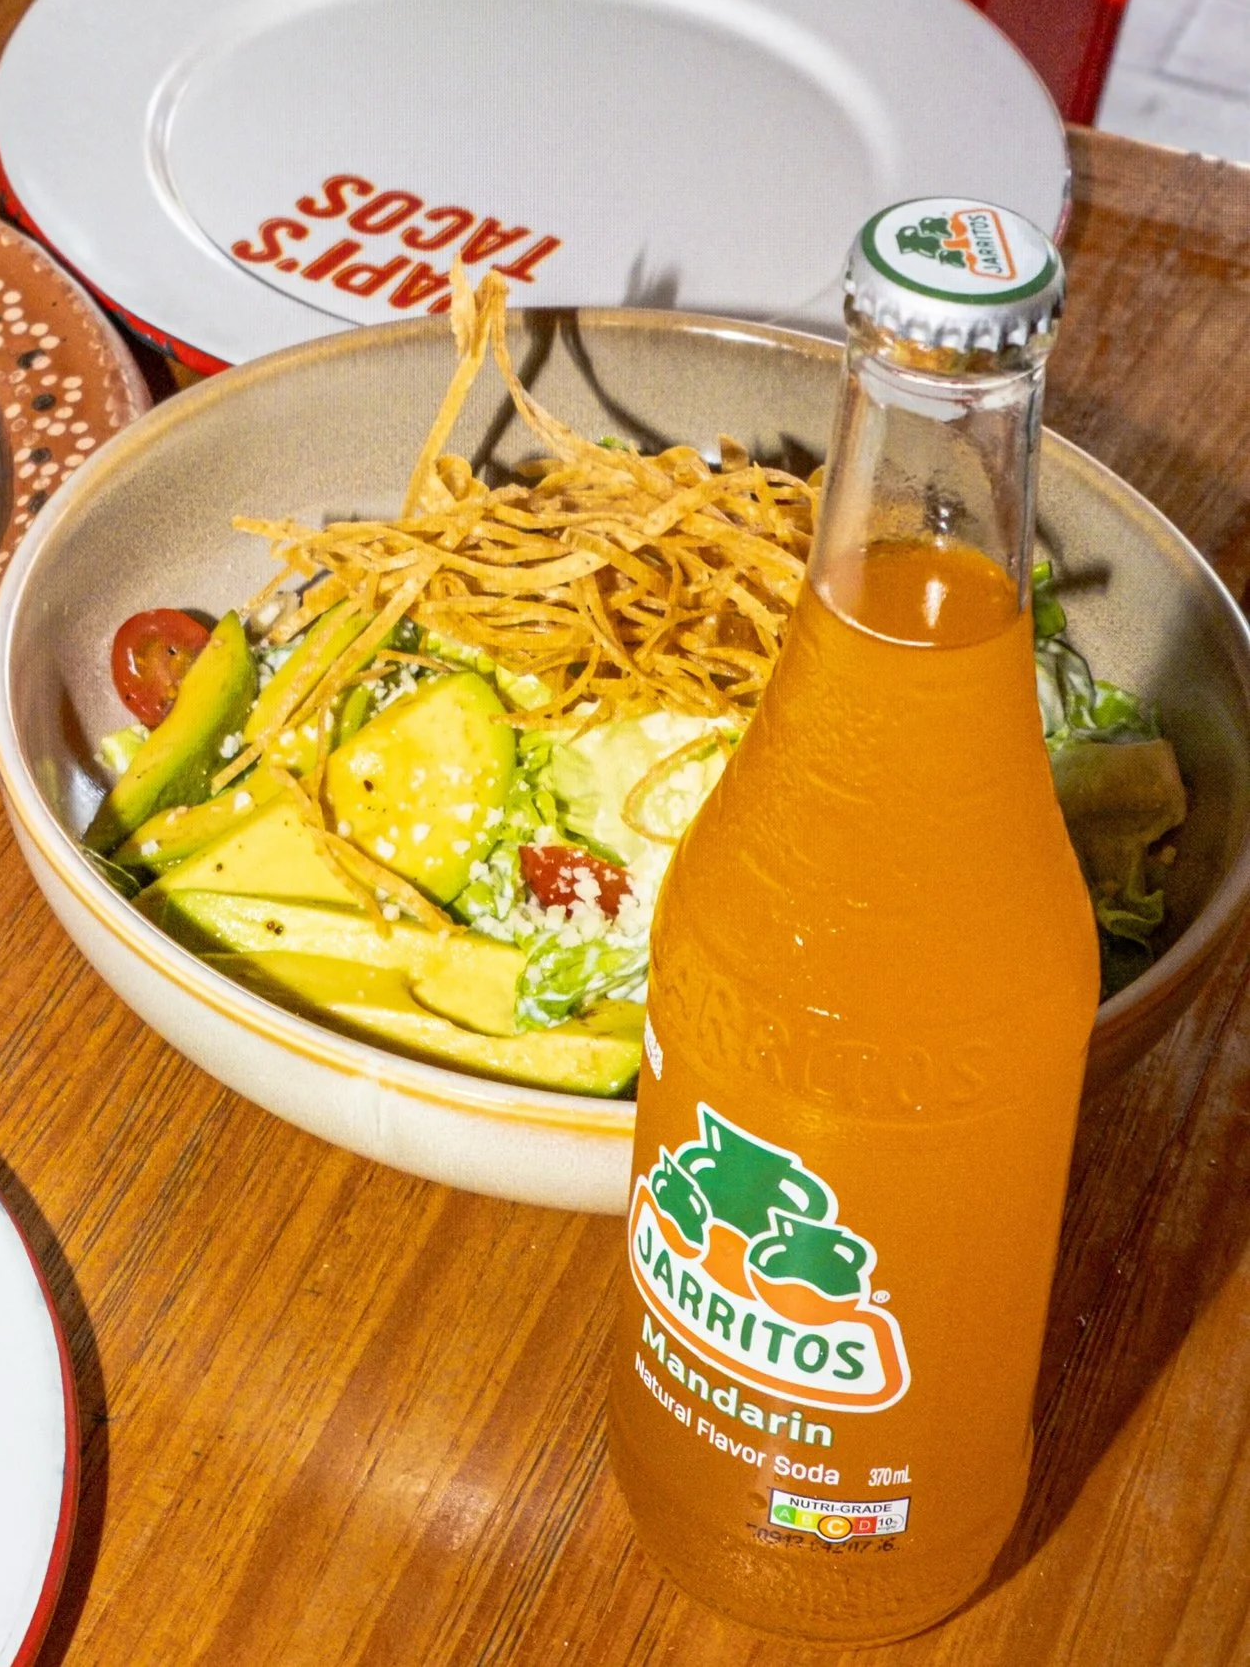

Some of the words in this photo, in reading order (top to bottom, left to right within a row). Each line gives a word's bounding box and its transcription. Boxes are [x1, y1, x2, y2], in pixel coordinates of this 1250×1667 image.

[231, 217, 452, 315] API'S
[296, 174, 562, 283] TACOS
[968, 214, 1003, 274] JARRITOS
[638, 1231, 866, 1380] JARRITOS
[635, 1352, 691, 1427] Natural
[697, 1417, 767, 1467] Flavor
[774, 1455, 840, 1485] Soda
[642, 1314, 834, 1447] Mandarin
[789, 1497, 893, 1514] NUTRI-GRADE
[826, 1519, 843, 1535] C
[859, 1520, 871, 1531] D
